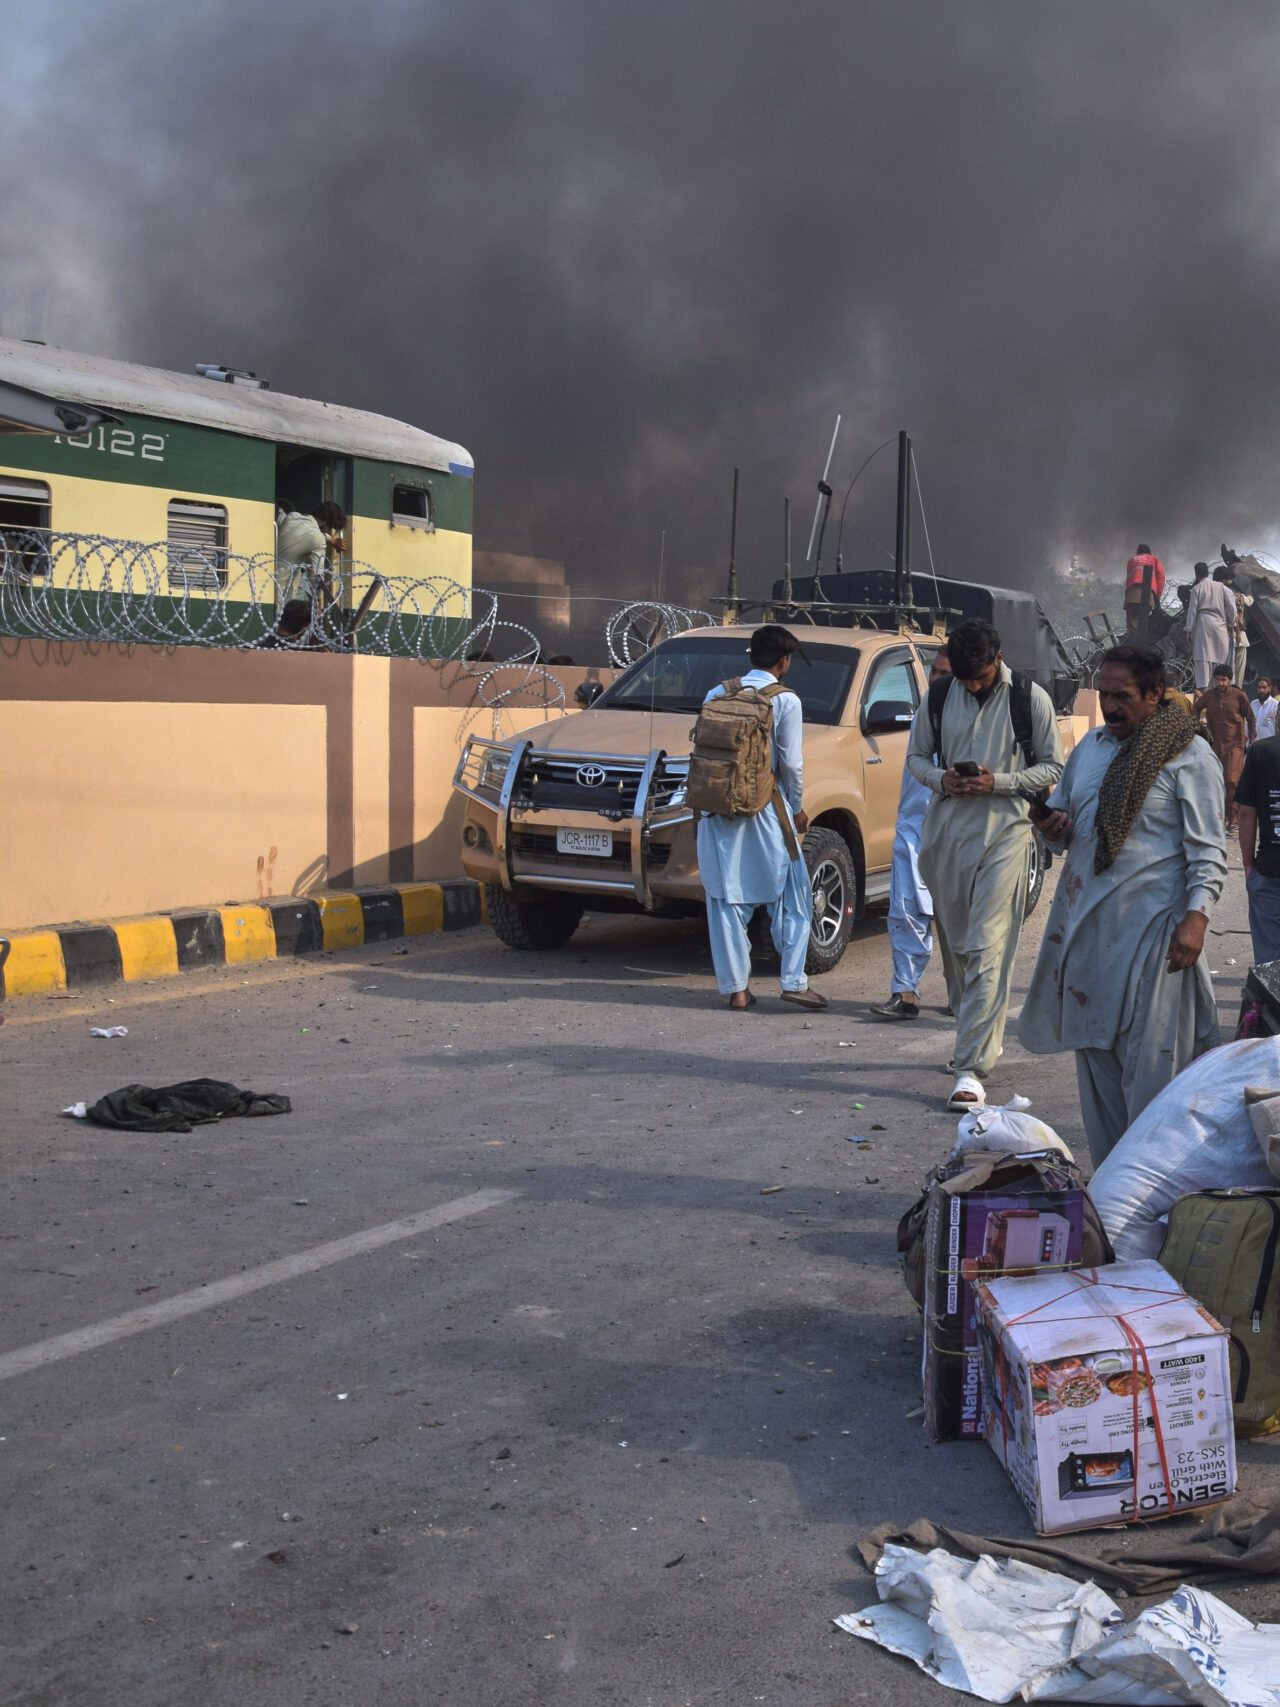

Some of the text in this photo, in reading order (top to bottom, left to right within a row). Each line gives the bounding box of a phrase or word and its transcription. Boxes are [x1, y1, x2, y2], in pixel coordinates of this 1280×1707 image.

[561, 831, 609, 848] JCR-1117 B
[949, 1287, 957, 1312] JUICER
[1162, 1356, 1203, 1369] 1400 WATT
[961, 1346, 980, 1420] National
[1169, 1420, 1194, 1429] DEFROST
[1177, 1445, 1226, 1464] SKS-23
[1171, 1460, 1227, 1478] With Grill
[1149, 1470, 1227, 1491] Electric Oen
[1119, 1481, 1228, 1515] SENCOR
